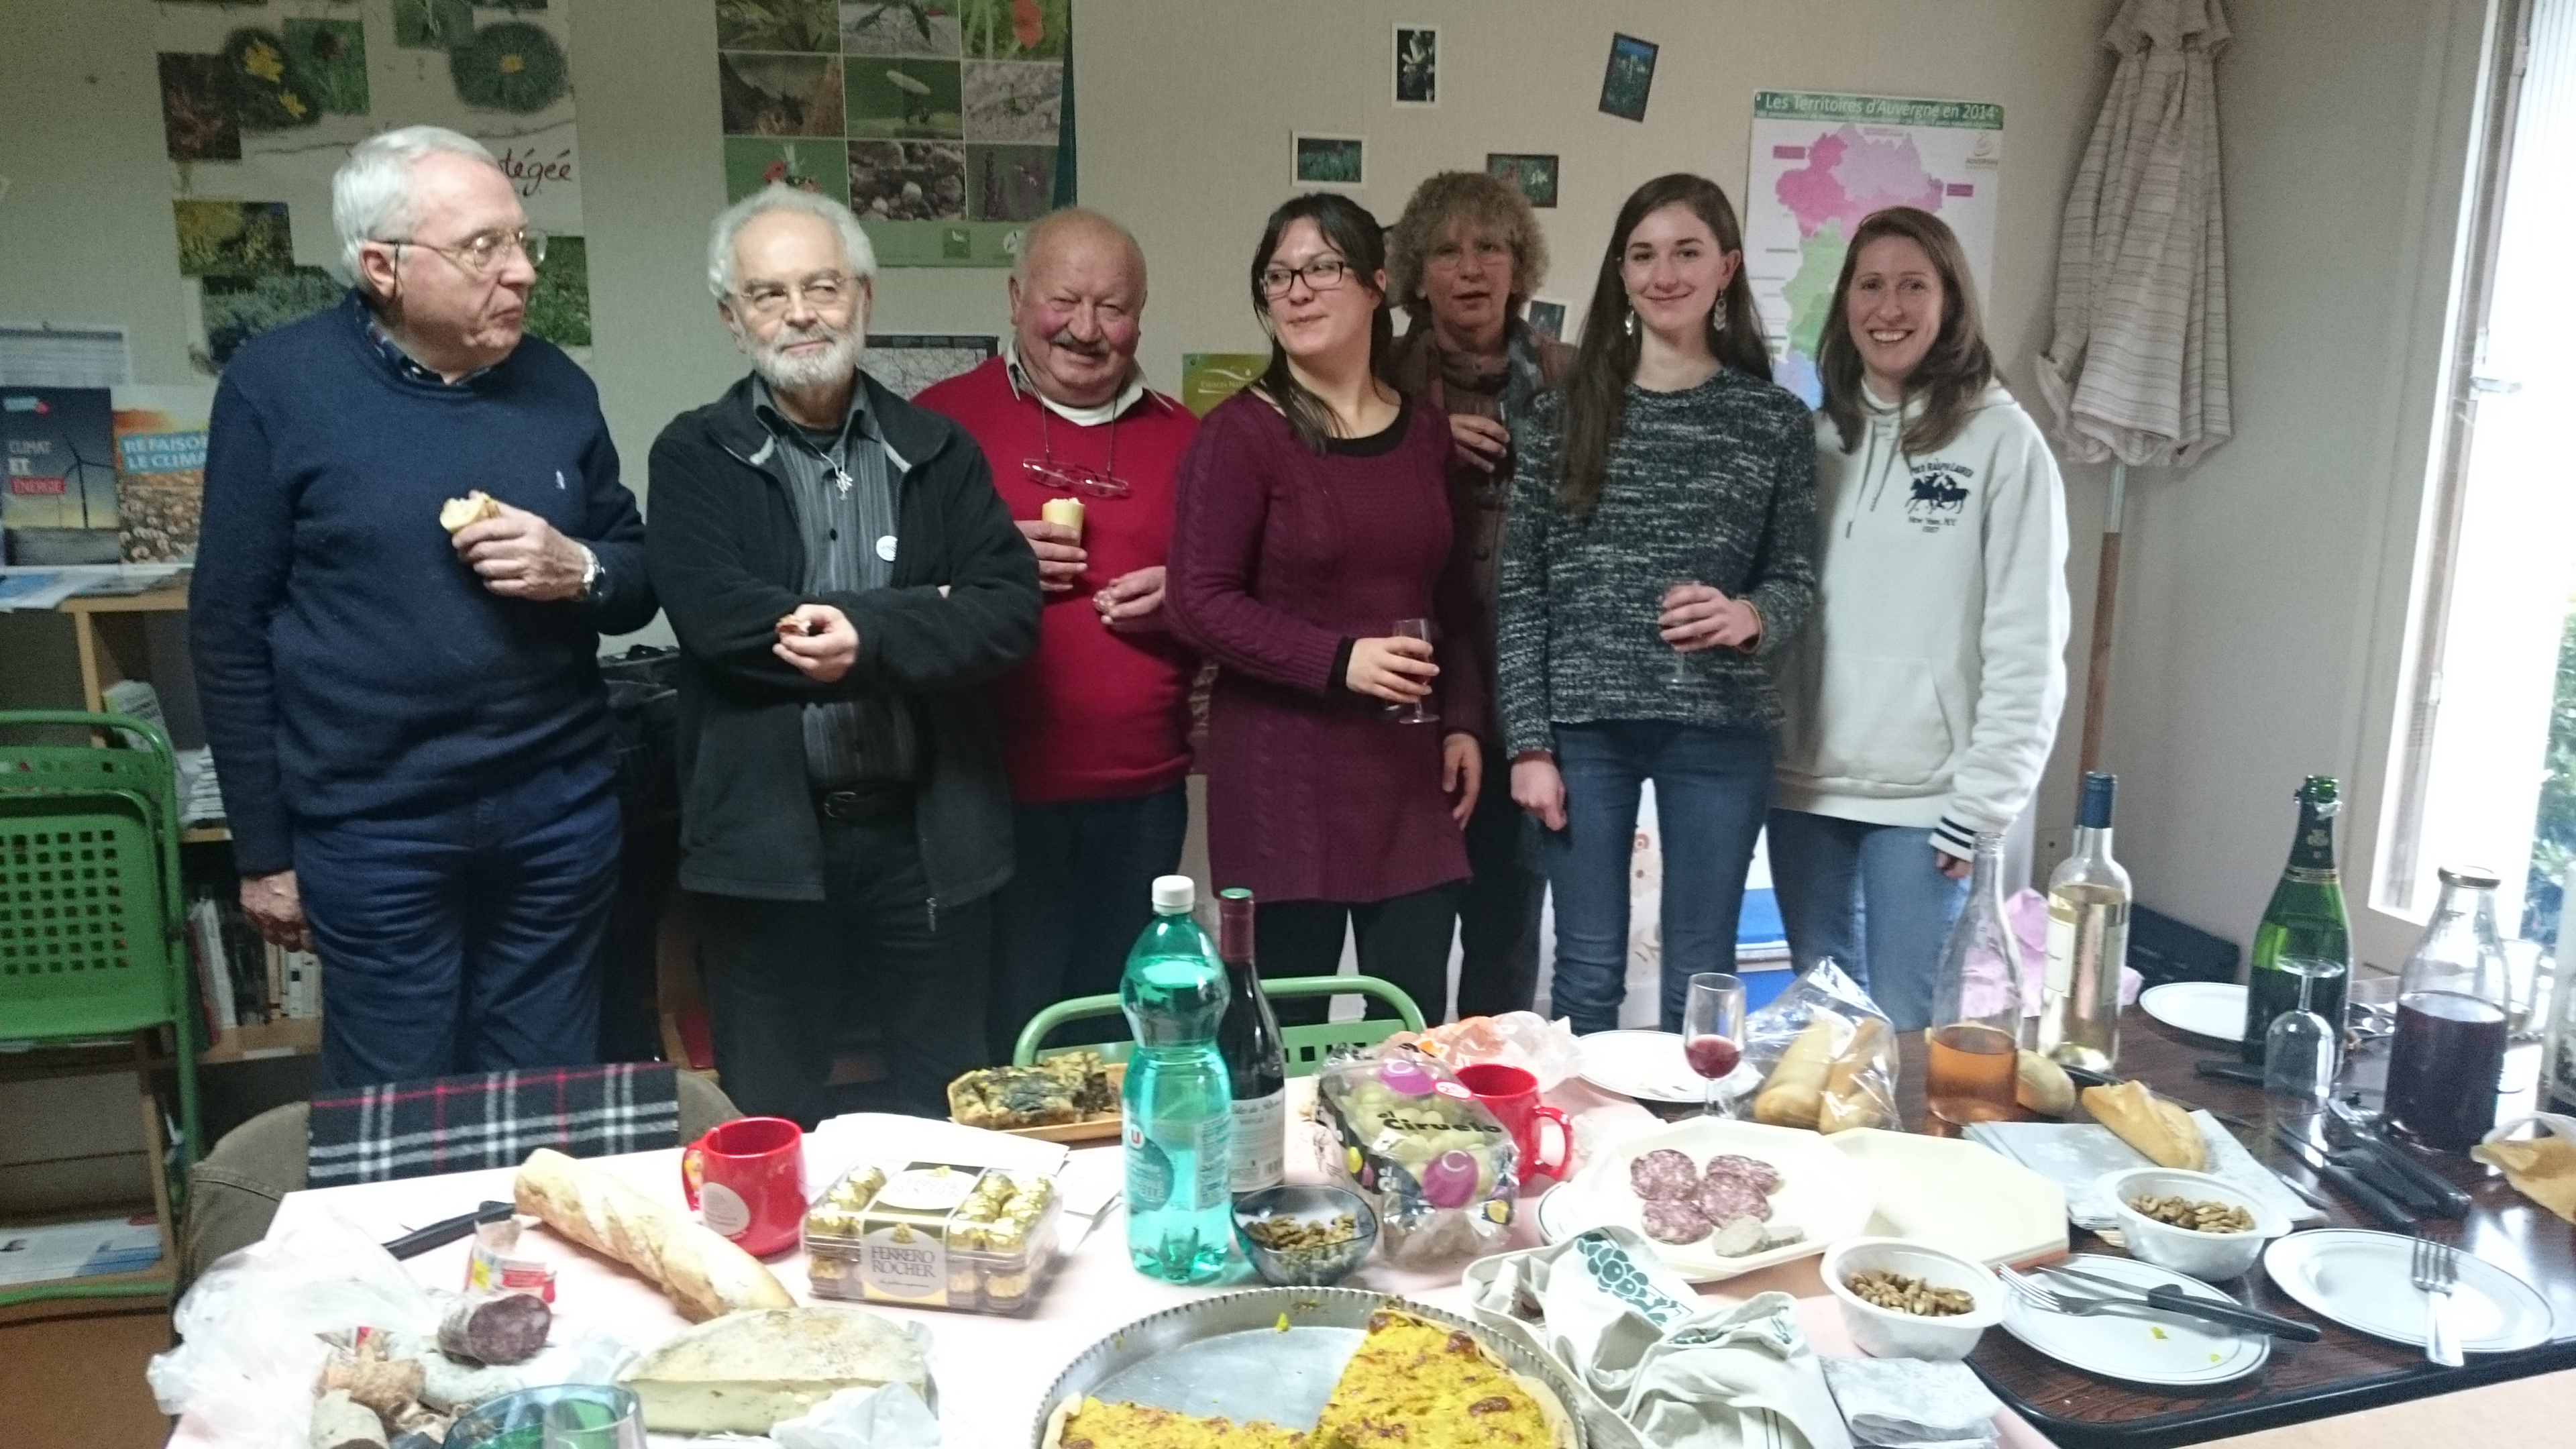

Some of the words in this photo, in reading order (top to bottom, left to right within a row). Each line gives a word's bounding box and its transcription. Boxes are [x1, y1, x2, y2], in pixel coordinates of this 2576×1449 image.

[1766, 93, 1789, 109] Les
[1794, 95, 1863, 113] Territoires
[1866, 99, 1940, 119] d'Auvergne
[1943, 105, 1960, 117] en
[1962, 103, 1996, 119] 2014
[8, 457, 32, 475] ET
[1377, 1111, 1395, 1119] el
[1383, 1118, 1503, 1134] Ciruelo
[871, 1246, 936, 1264] FERRERO
[871, 1259, 936, 1278] ROCHER
